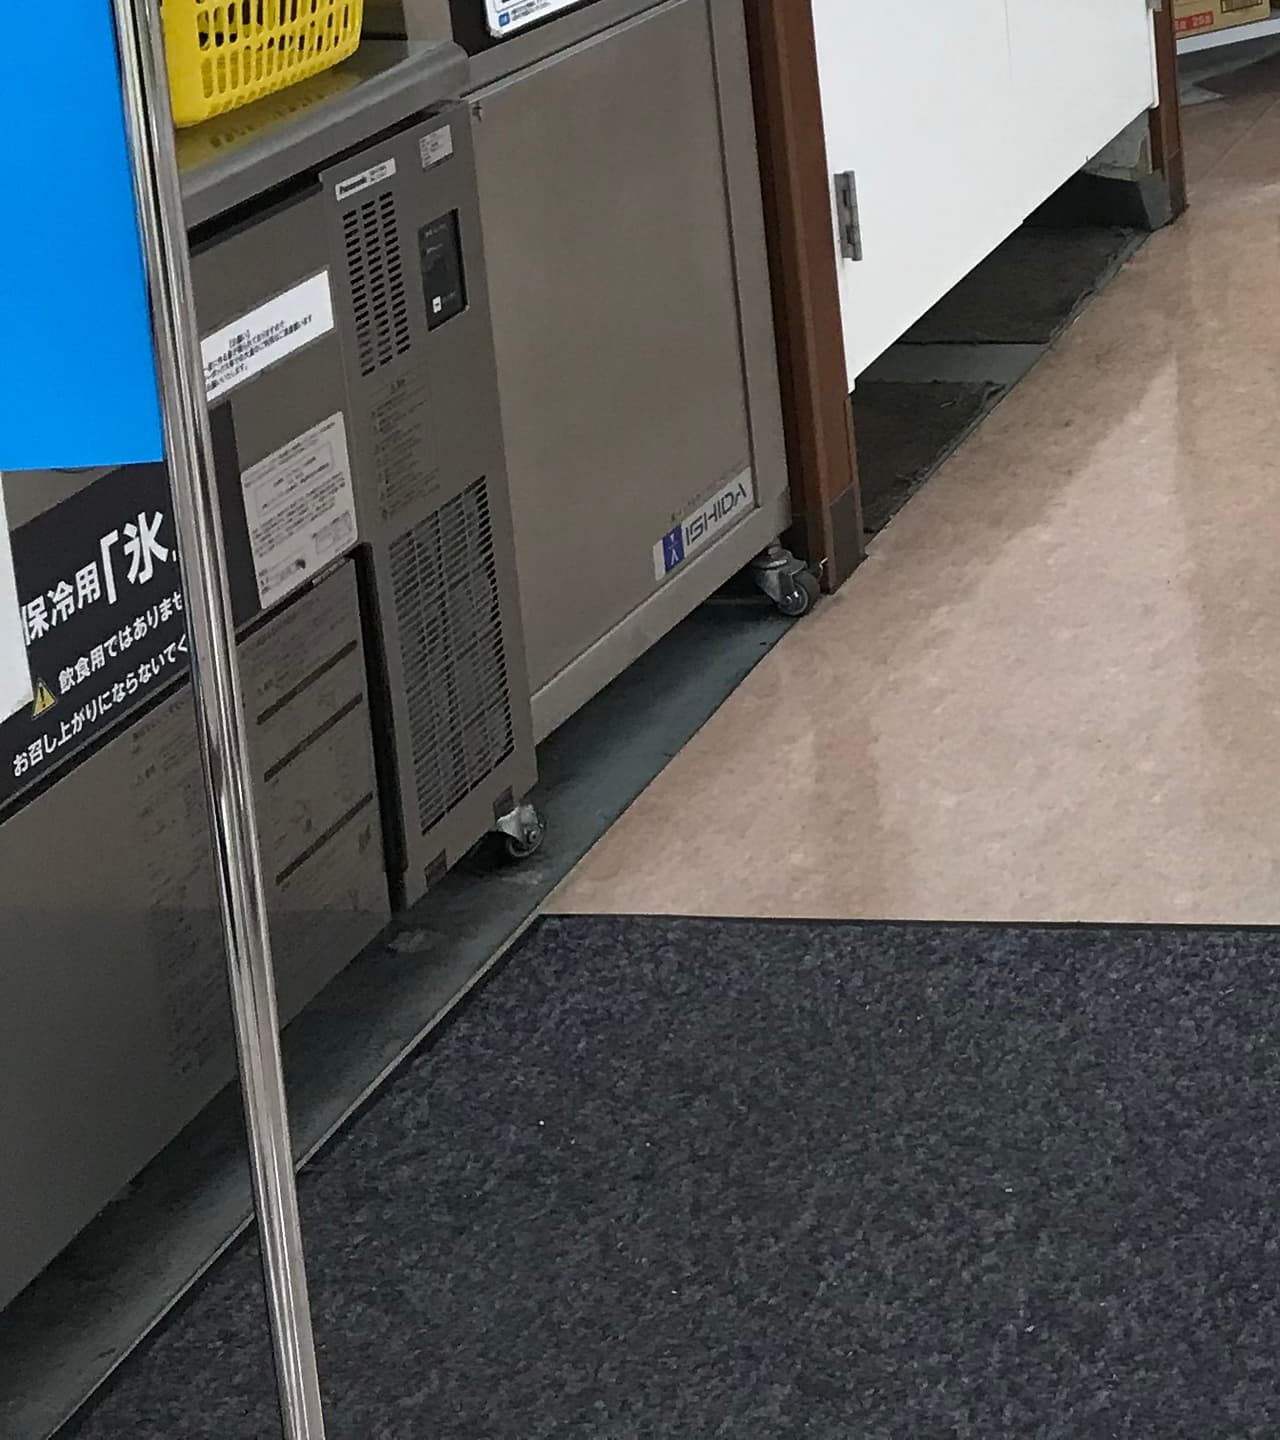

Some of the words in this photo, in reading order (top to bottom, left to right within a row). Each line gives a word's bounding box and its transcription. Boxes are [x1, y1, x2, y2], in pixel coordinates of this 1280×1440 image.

[686, 483, 747, 546] ISHIDA
[22, 511, 177, 646] 保冷用「氷
